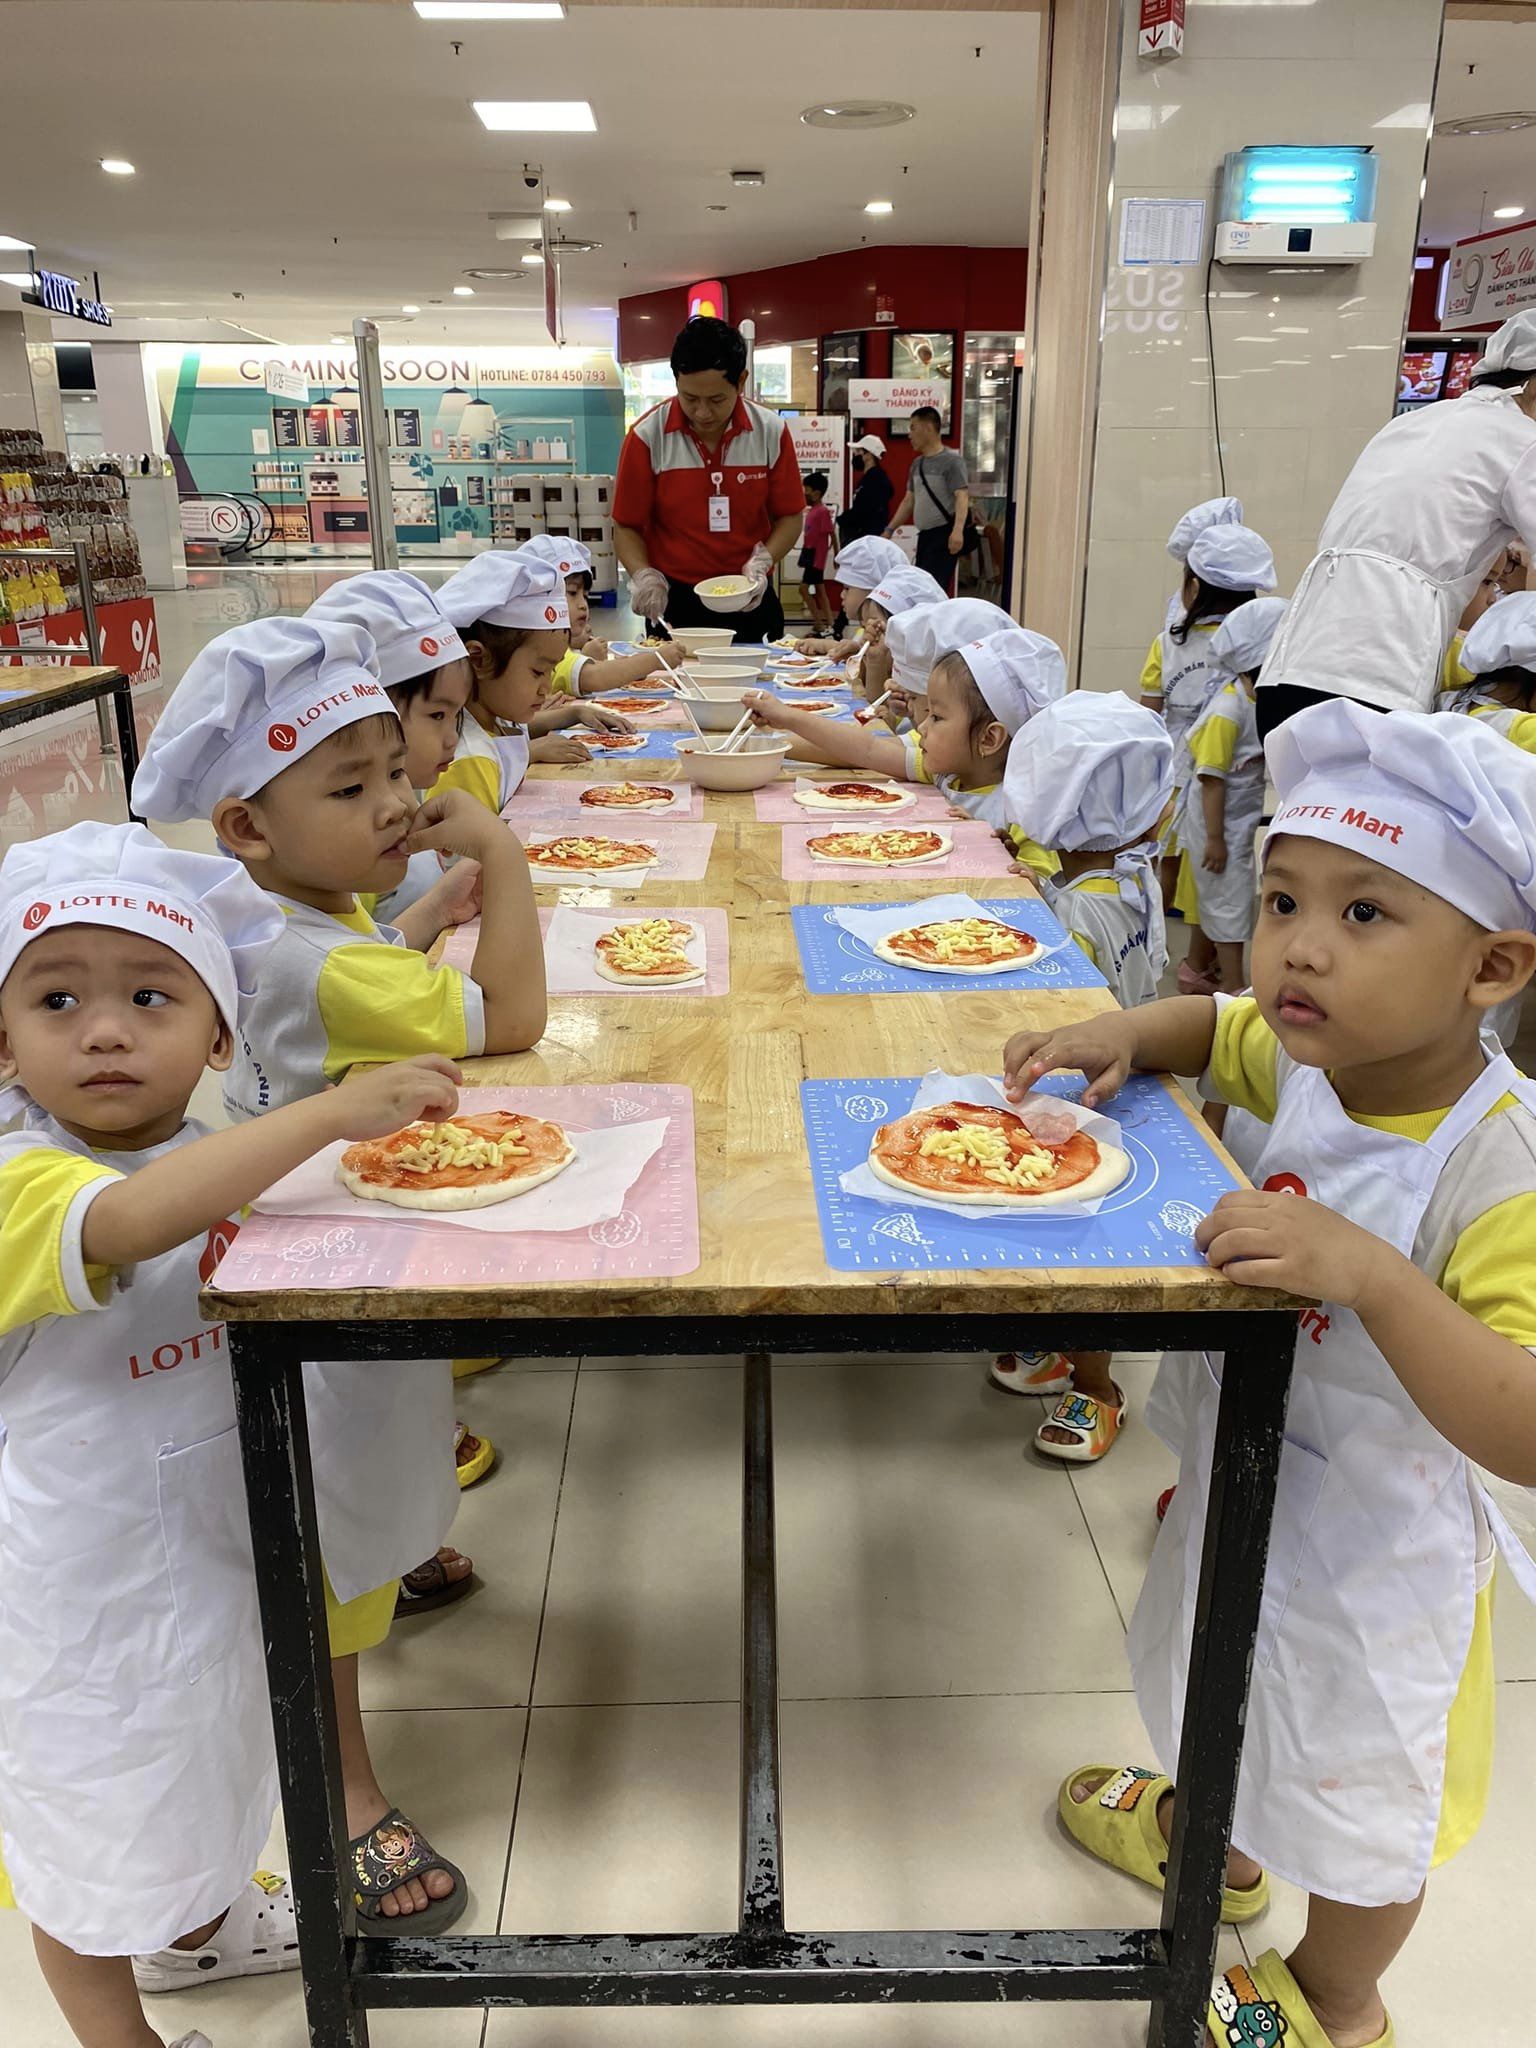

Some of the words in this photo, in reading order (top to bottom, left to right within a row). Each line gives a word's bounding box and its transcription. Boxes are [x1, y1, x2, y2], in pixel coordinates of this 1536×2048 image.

[82, 298, 109, 324] SHOES
[383, 359, 470, 382] SOON
[480, 370, 529, 381] HOTLINE:
[531, 370, 559, 382] 0784
[562, 370, 583, 382] 450
[587, 369, 606, 382] 793
[296, 690, 353, 728] LOTTE
[351, 683, 384, 699] Mart
[1339, 807, 1404, 845] Mart
[60, 895, 137, 910] LOTTE
[146, 900, 194, 934] Mart
[128, 1323, 225, 1380] LOTT
